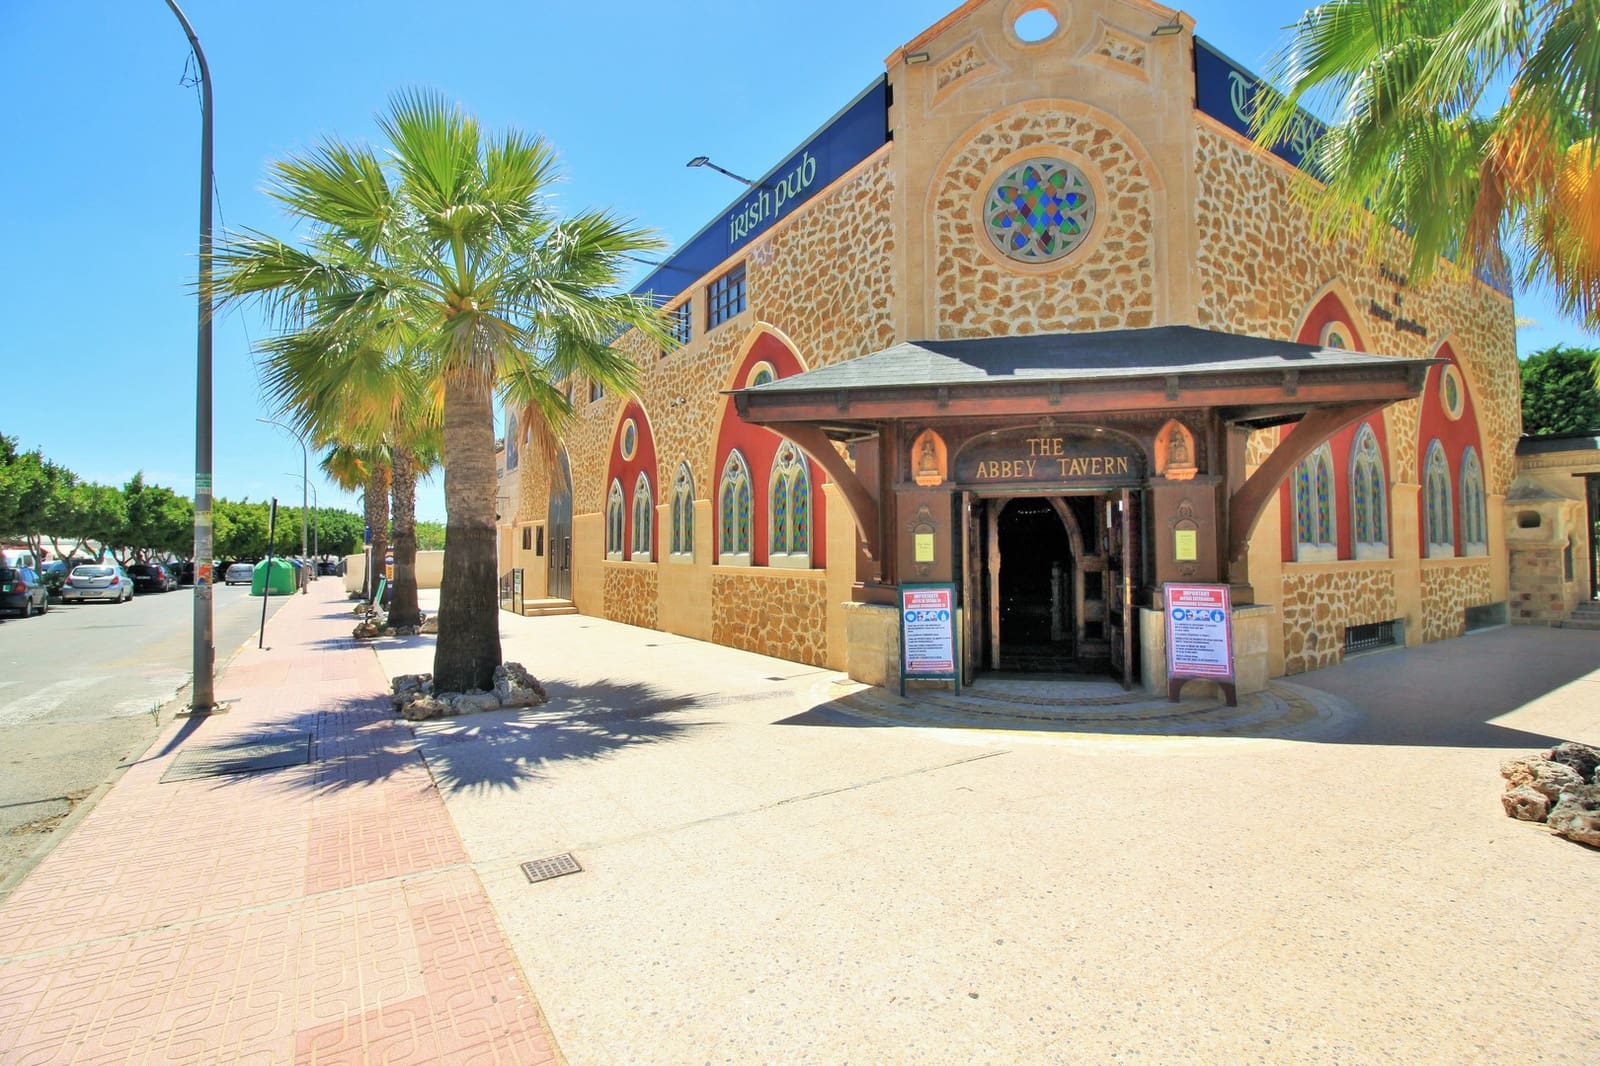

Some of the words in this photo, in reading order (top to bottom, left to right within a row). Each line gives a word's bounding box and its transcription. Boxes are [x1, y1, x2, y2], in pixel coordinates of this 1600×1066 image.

[775, 151, 816, 219] pub
[1026, 438, 1064, 456] THE
[976, 460, 1037, 479] ABBEY
[1056, 456, 1129, 477] TAVERN
